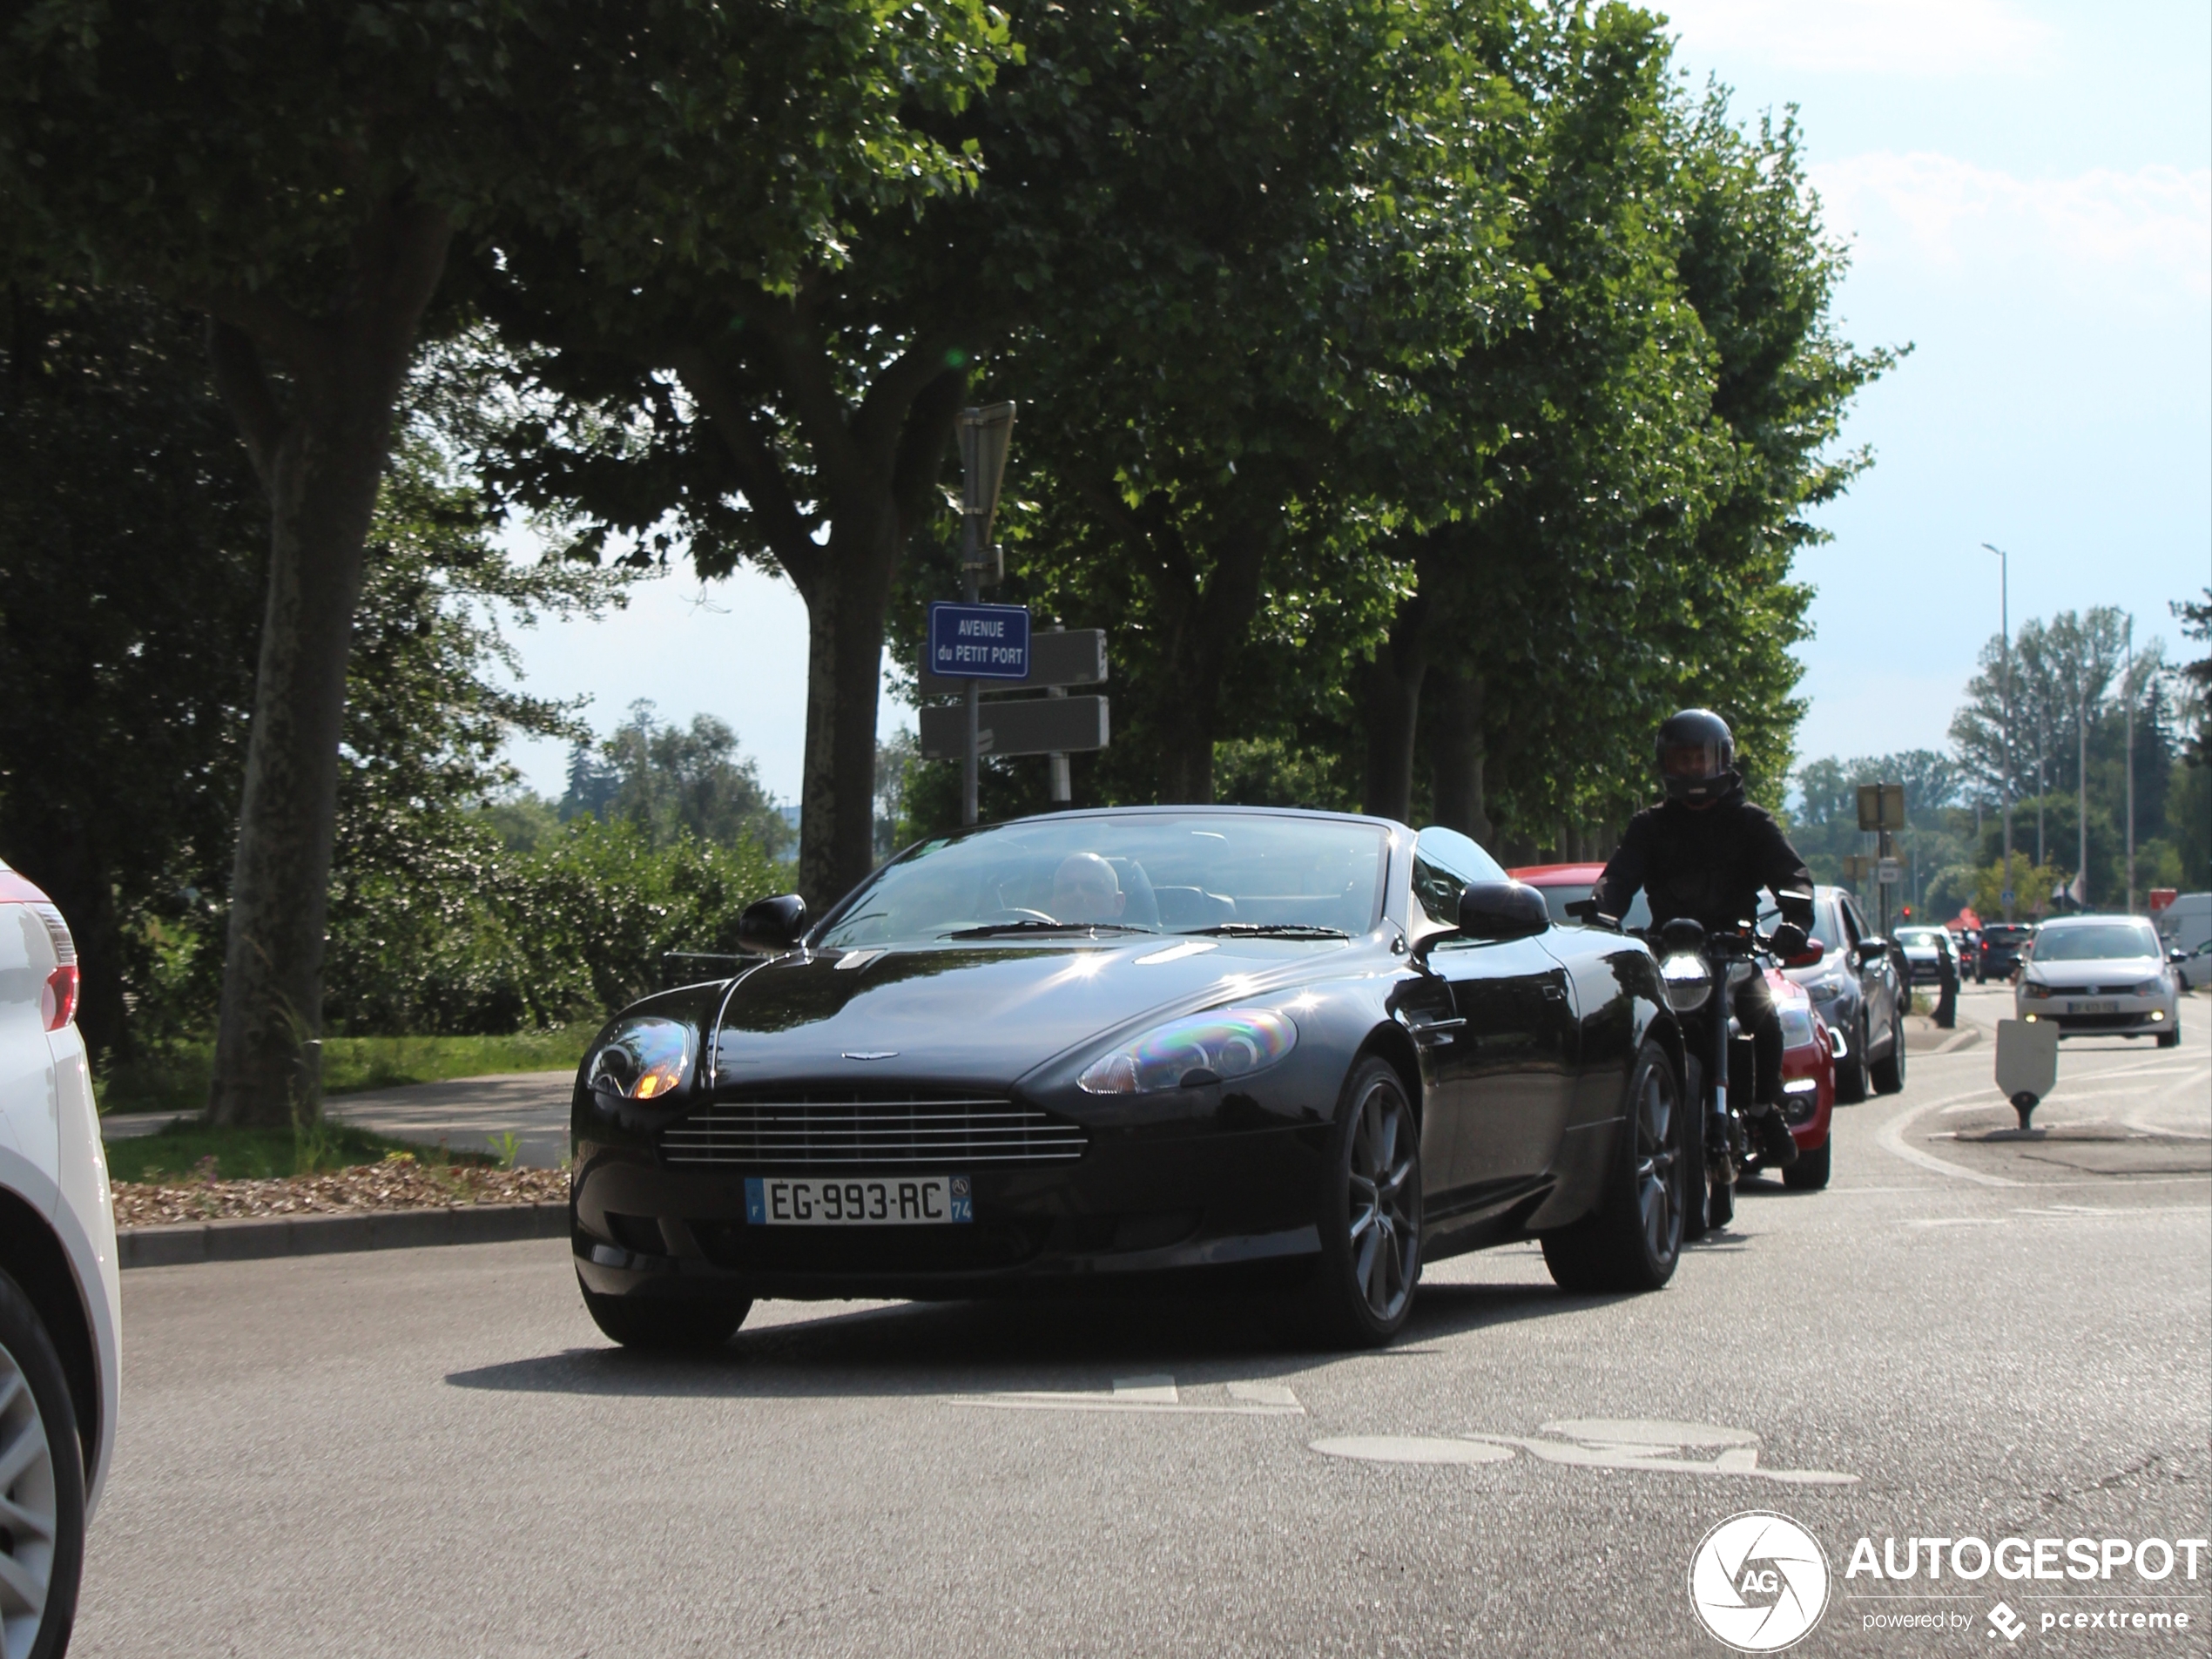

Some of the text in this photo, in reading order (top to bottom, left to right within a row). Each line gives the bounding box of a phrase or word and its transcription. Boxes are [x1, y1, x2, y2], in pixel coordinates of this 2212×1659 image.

[958, 620, 1004, 637] AVENUE
[938, 645, 1022, 664] du PETIT PORT
[752, 1183, 971, 1220] F EG-993-RC 74
